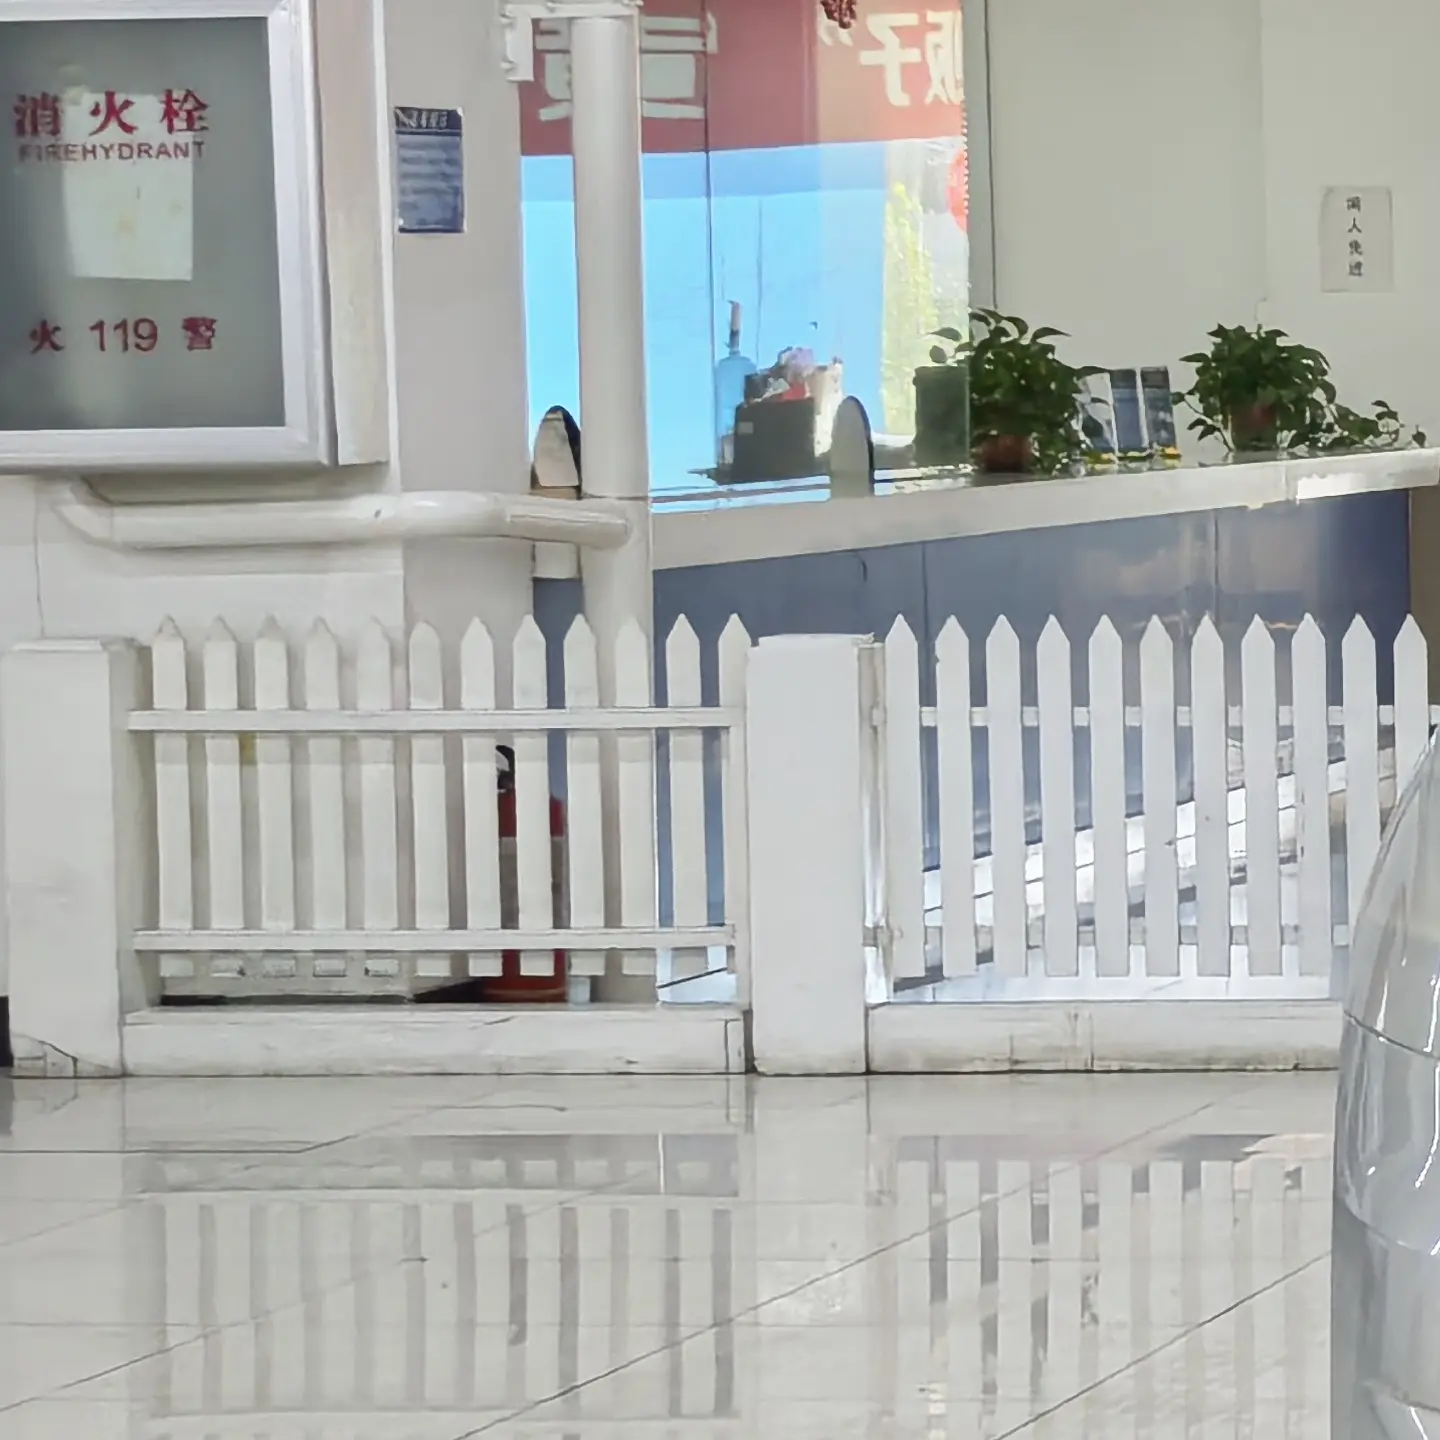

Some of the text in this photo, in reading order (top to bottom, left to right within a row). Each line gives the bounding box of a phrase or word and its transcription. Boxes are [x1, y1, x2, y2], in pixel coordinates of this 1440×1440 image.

[13, 88, 209, 138] 消火栓
[89, 317, 158, 353] 119
